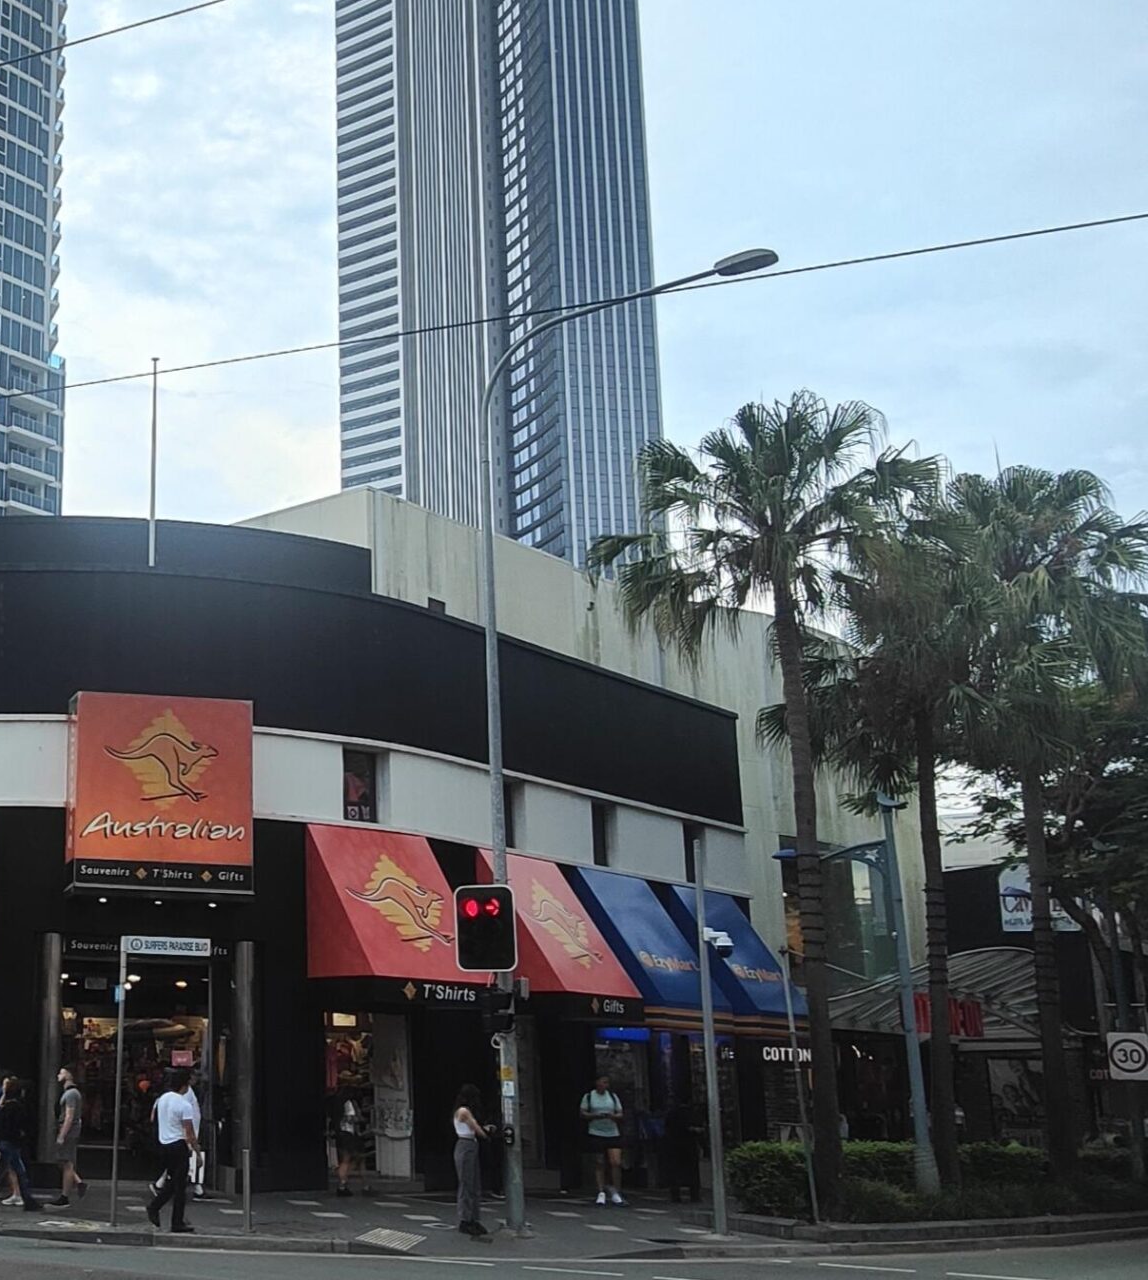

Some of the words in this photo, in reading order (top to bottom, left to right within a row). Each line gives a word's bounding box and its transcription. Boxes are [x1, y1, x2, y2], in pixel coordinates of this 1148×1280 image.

[82, 811, 245, 841] Australian
[80, 864, 130, 877] Souvenirs
[152, 868, 193, 880] T'Shirts
[218, 871, 244, 882] Gifts
[71, 939, 118, 952] Souvenirs
[212, 946, 228, 956] fts
[144, 940, 168, 951] SURFERS
[169, 940, 193, 952] PARADISE
[423, 983, 476, 1001] T'Shirts
[603, 999, 625, 1014] Gifts
[1116, 1048, 1142, 1064] 30
